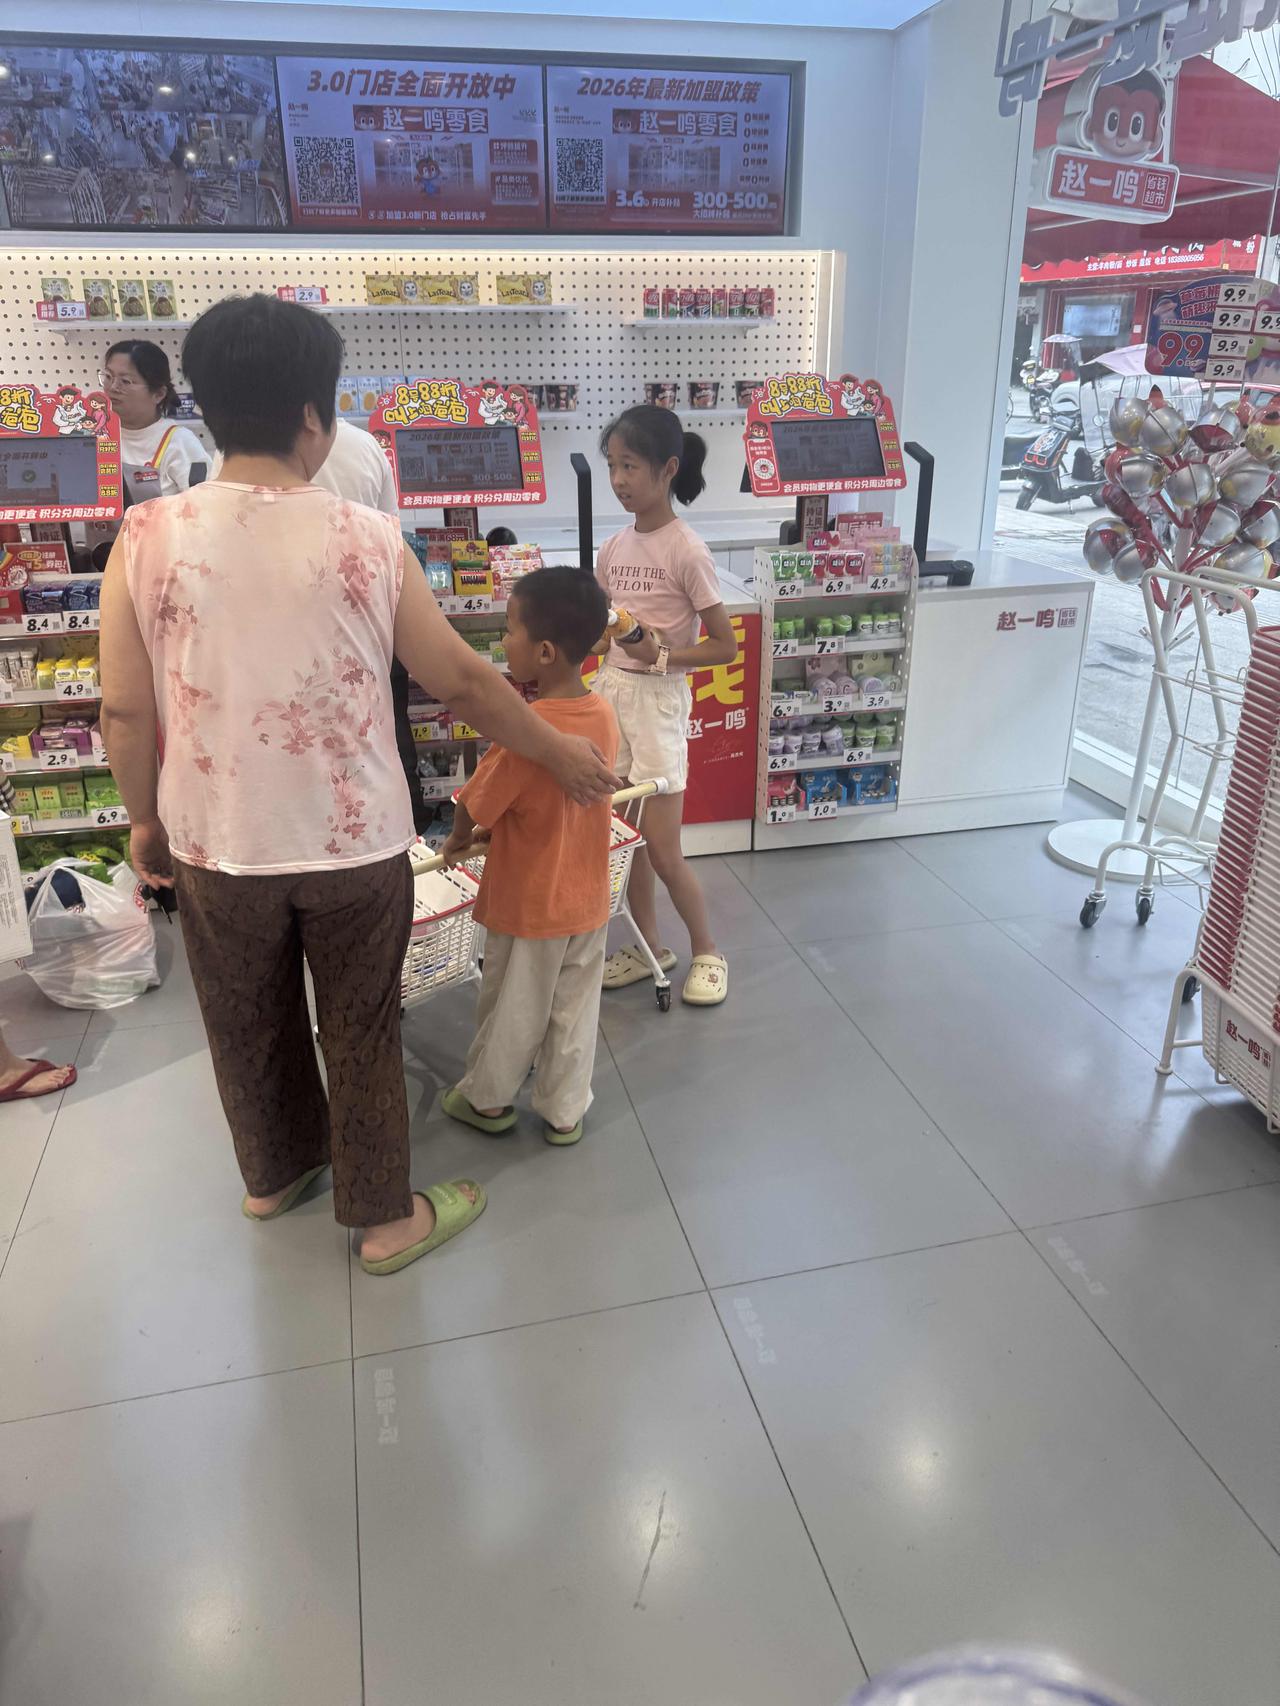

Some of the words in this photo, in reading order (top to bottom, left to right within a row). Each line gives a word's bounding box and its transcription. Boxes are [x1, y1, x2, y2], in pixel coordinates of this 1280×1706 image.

[306, 68, 517, 100] 3.0门店全面开放中
[576, 76, 763, 104] 2026年最新加盟政策
[382, 106, 488, 133] 赵一鸣零食
[639, 110, 737, 137] 赵一鸣零食
[1057, 159, 1141, 204] 赵一鸣
[299, 290, 314, 301] 2.9
[1223, 288, 1246, 302] 9.9
[60, 306, 77, 317] 5.9
[1218, 313, 1241, 327] 9.9
[1158, 332, 1204, 367] 9.9
[1216, 340, 1238, 352] 9.9
[1213, 364, 1235, 376] 9.9
[783, 481, 843, 493] 会员购物更便宜
[844, 478, 902, 489] 积分兑周边零食
[403, 494, 472, 506] 会员购物更便宜
[473, 491, 541, 504] 积分兑周边零食
[39, 506, 117, 519] 积分兑周边零食
[610, 565, 641, 578] WITH
[643, 567, 666, 581] THE
[616, 580, 654, 593] FLOW
[778, 584, 796, 596] 6.9
[825, 581, 844, 593] 6.9
[870, 577, 888, 590] 4.9
[464, 599, 483, 610] 4.5
[26, 618, 49, 632] 8.4
[68, 615, 90, 629] 8.4
[996, 608, 1055, 631] 赵一鸣
[773, 643, 789, 656] 7.4
[817, 641, 836, 654] 7.8
[63, 684, 84, 696] 4.9
[823, 700, 842, 713] 3.9
[867, 696, 884, 707] 3.9
[773, 705, 792, 717] 6.9
[47, 754, 67, 766] 2.9
[770, 758, 787, 769] 6.9
[846, 751, 864, 763] 6.9
[97, 810, 118, 824] 6.9
[770, 810, 787, 822] 1.0
[813, 805, 830, 817] 1.0
[1226, 1019, 1261, 1060] 赵一鸣
